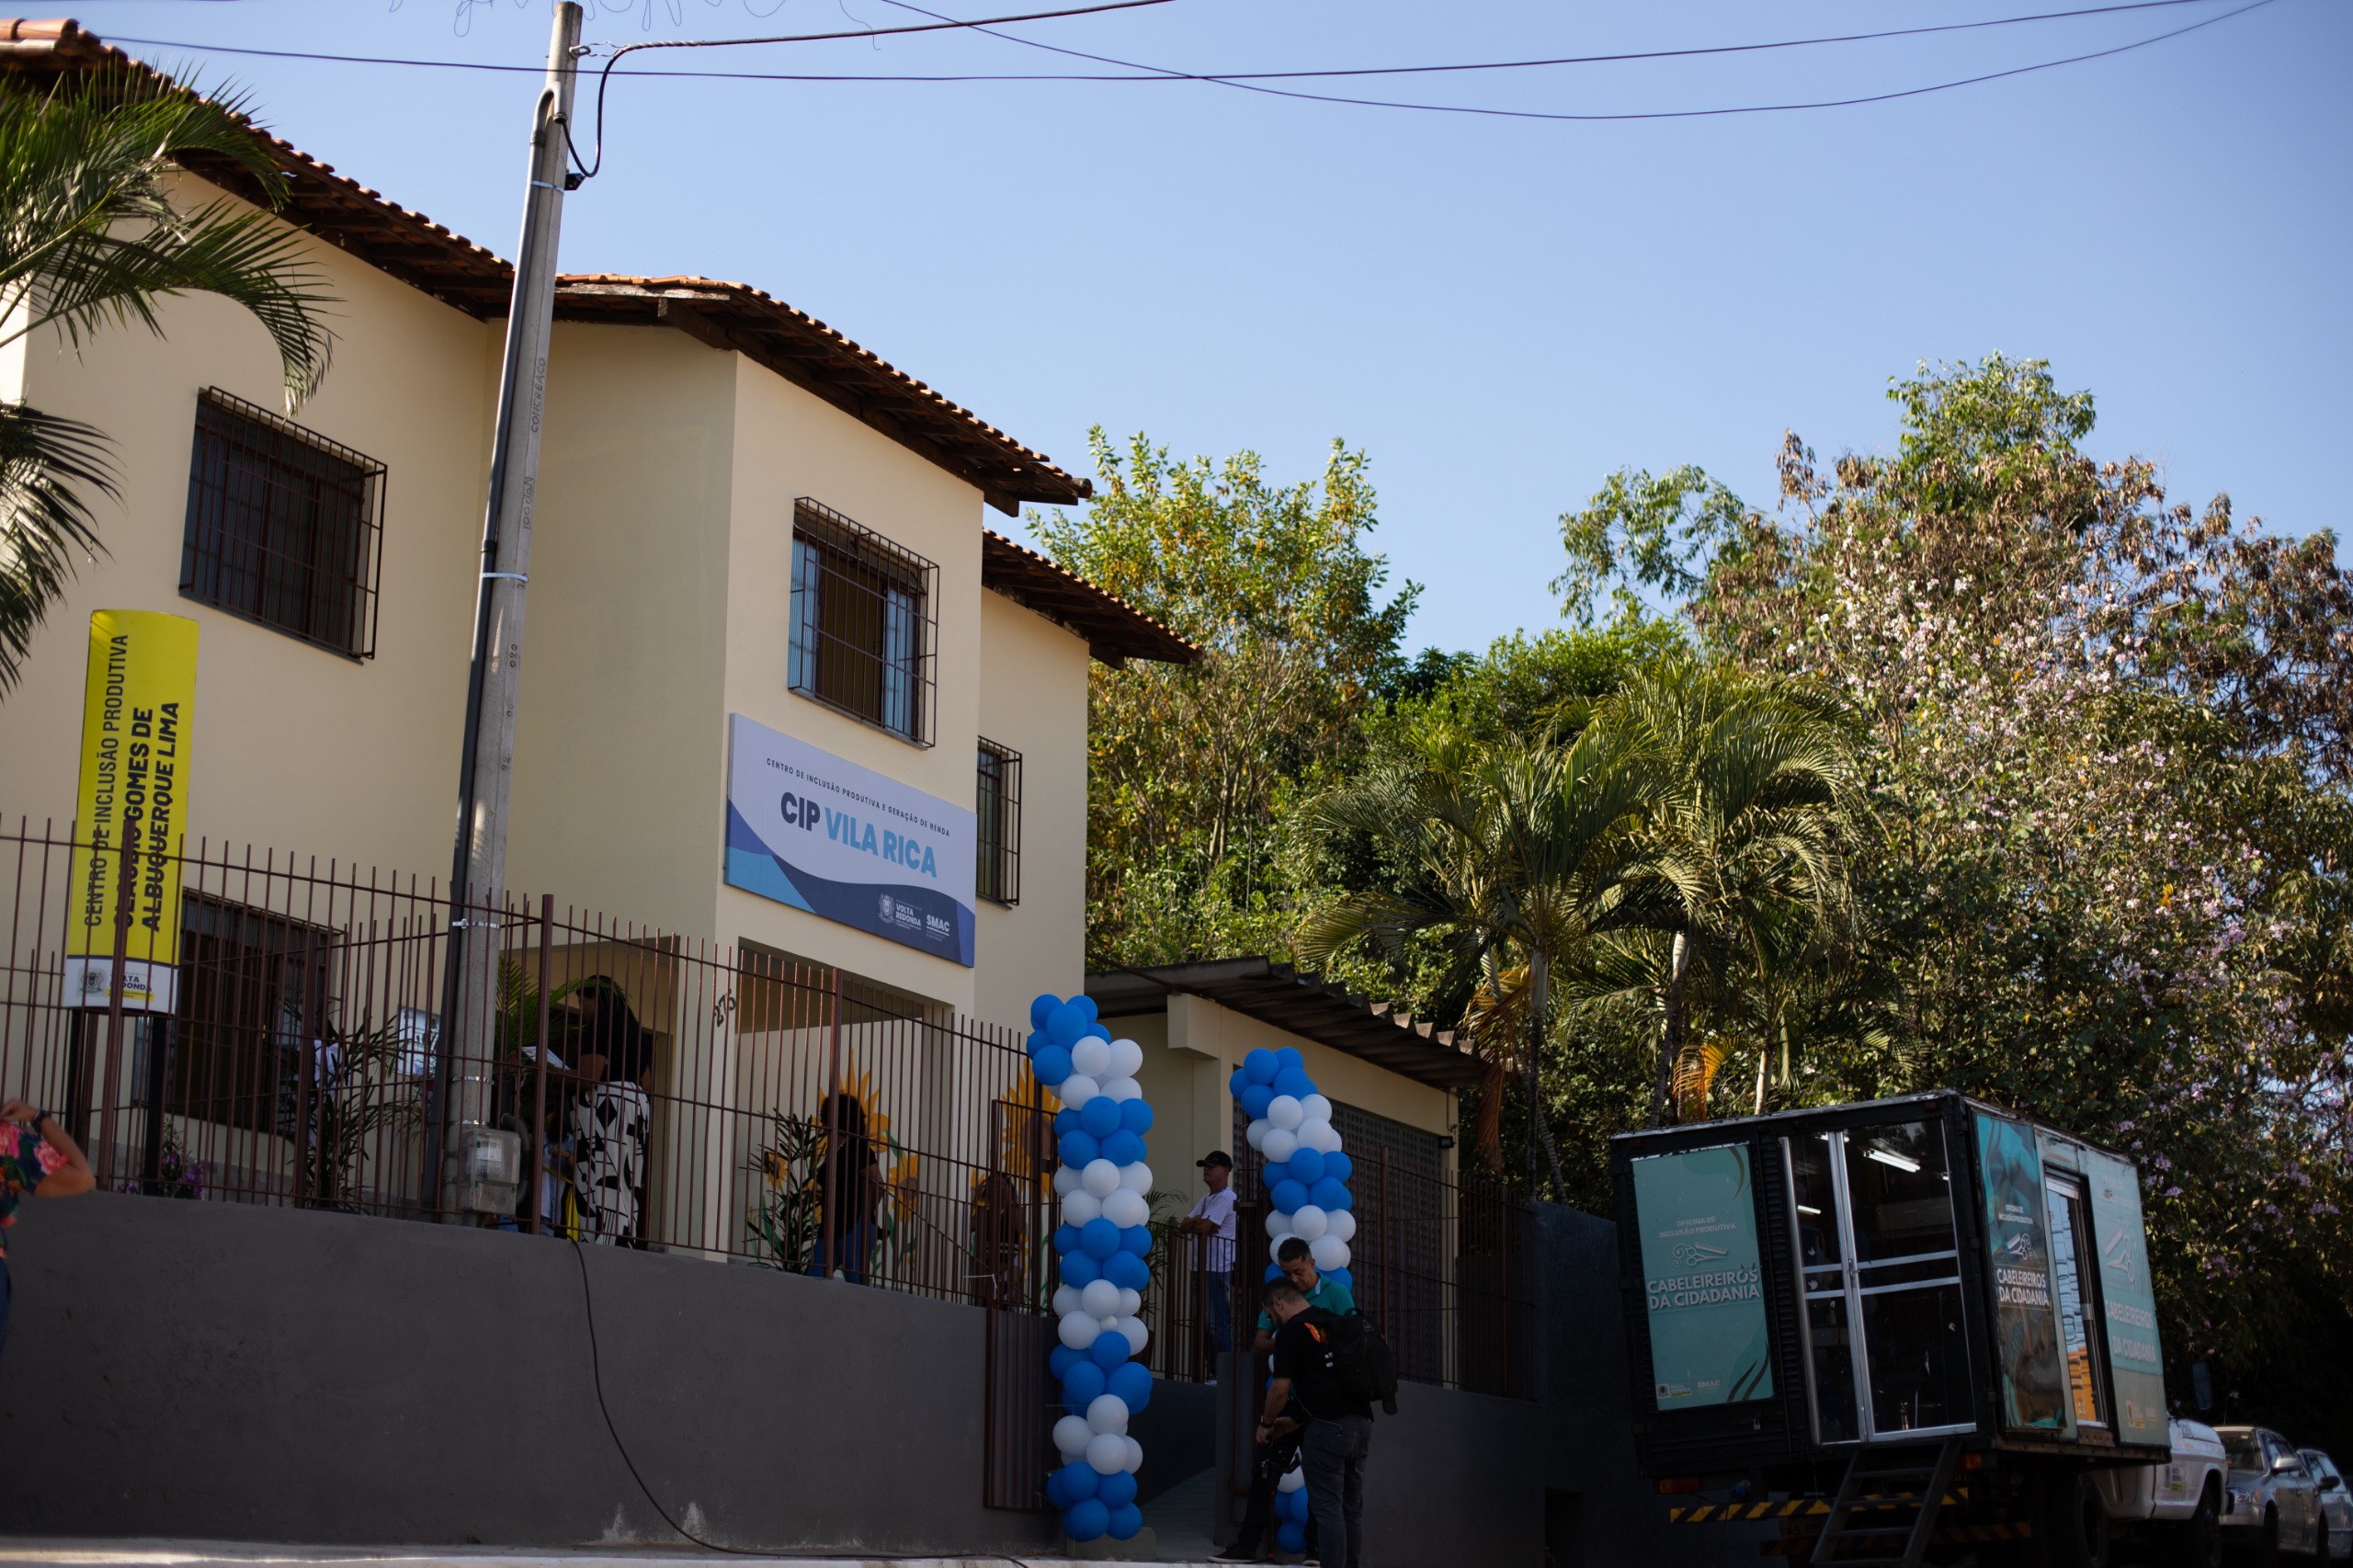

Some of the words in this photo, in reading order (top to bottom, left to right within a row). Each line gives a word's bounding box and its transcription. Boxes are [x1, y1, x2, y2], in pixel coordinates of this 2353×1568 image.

[103, 634, 128, 732] PRODUTIVA
[131, 707, 153, 738] DE
[156, 702, 179, 758] LIMA
[95, 737, 119, 824] INCLUSÃO
[123, 742, 150, 822] GOMES
[767, 758, 794, 775] CENTRO
[796, 769, 804, 778] DE
[806, 774, 840, 793] INCLUSÃO
[842, 789, 881, 809] PRODUTIVA
[882, 803, 886, 812] E
[888, 806, 918, 824] GERAÇÃO
[920, 819, 928, 828] DE
[929, 823, 950, 837] RENDA
[92, 829, 109, 851] DE
[142, 760, 175, 933] ALBUQUERQUE
[780, 791, 821, 832] CIP
[824, 806, 879, 857] VILA
[883, 829, 938, 879] RICA
[84, 858, 108, 927] CENTRO
[895, 903, 914, 916] VOLTA
[895, 911, 922, 927] REDONDA
[926, 914, 950, 933] SMAC
[713, 988, 736, 1028] 275
[1659, 1227, 1695, 1238] INCLUSÃO
[1695, 1222, 1736, 1233] PRODUTIVA
[1677, 1218, 1706, 1227] OFICINA
[1647, 1269, 1758, 1294] CABELEIREIROS
[1996, 1268, 2047, 1290] CABELEIREIROS
[1648, 1295, 1671, 1309] DA
[1674, 1284, 1761, 1306] CIDADANIA
[1998, 1286, 2011, 1302] DA
[2011, 1287, 2050, 1306] CIDADANIA
[2105, 1299, 2154, 1330] CABELEIREIROS
[2112, 1335, 2122, 1357] DA
[2123, 1337, 2157, 1363] CIDADANIA
